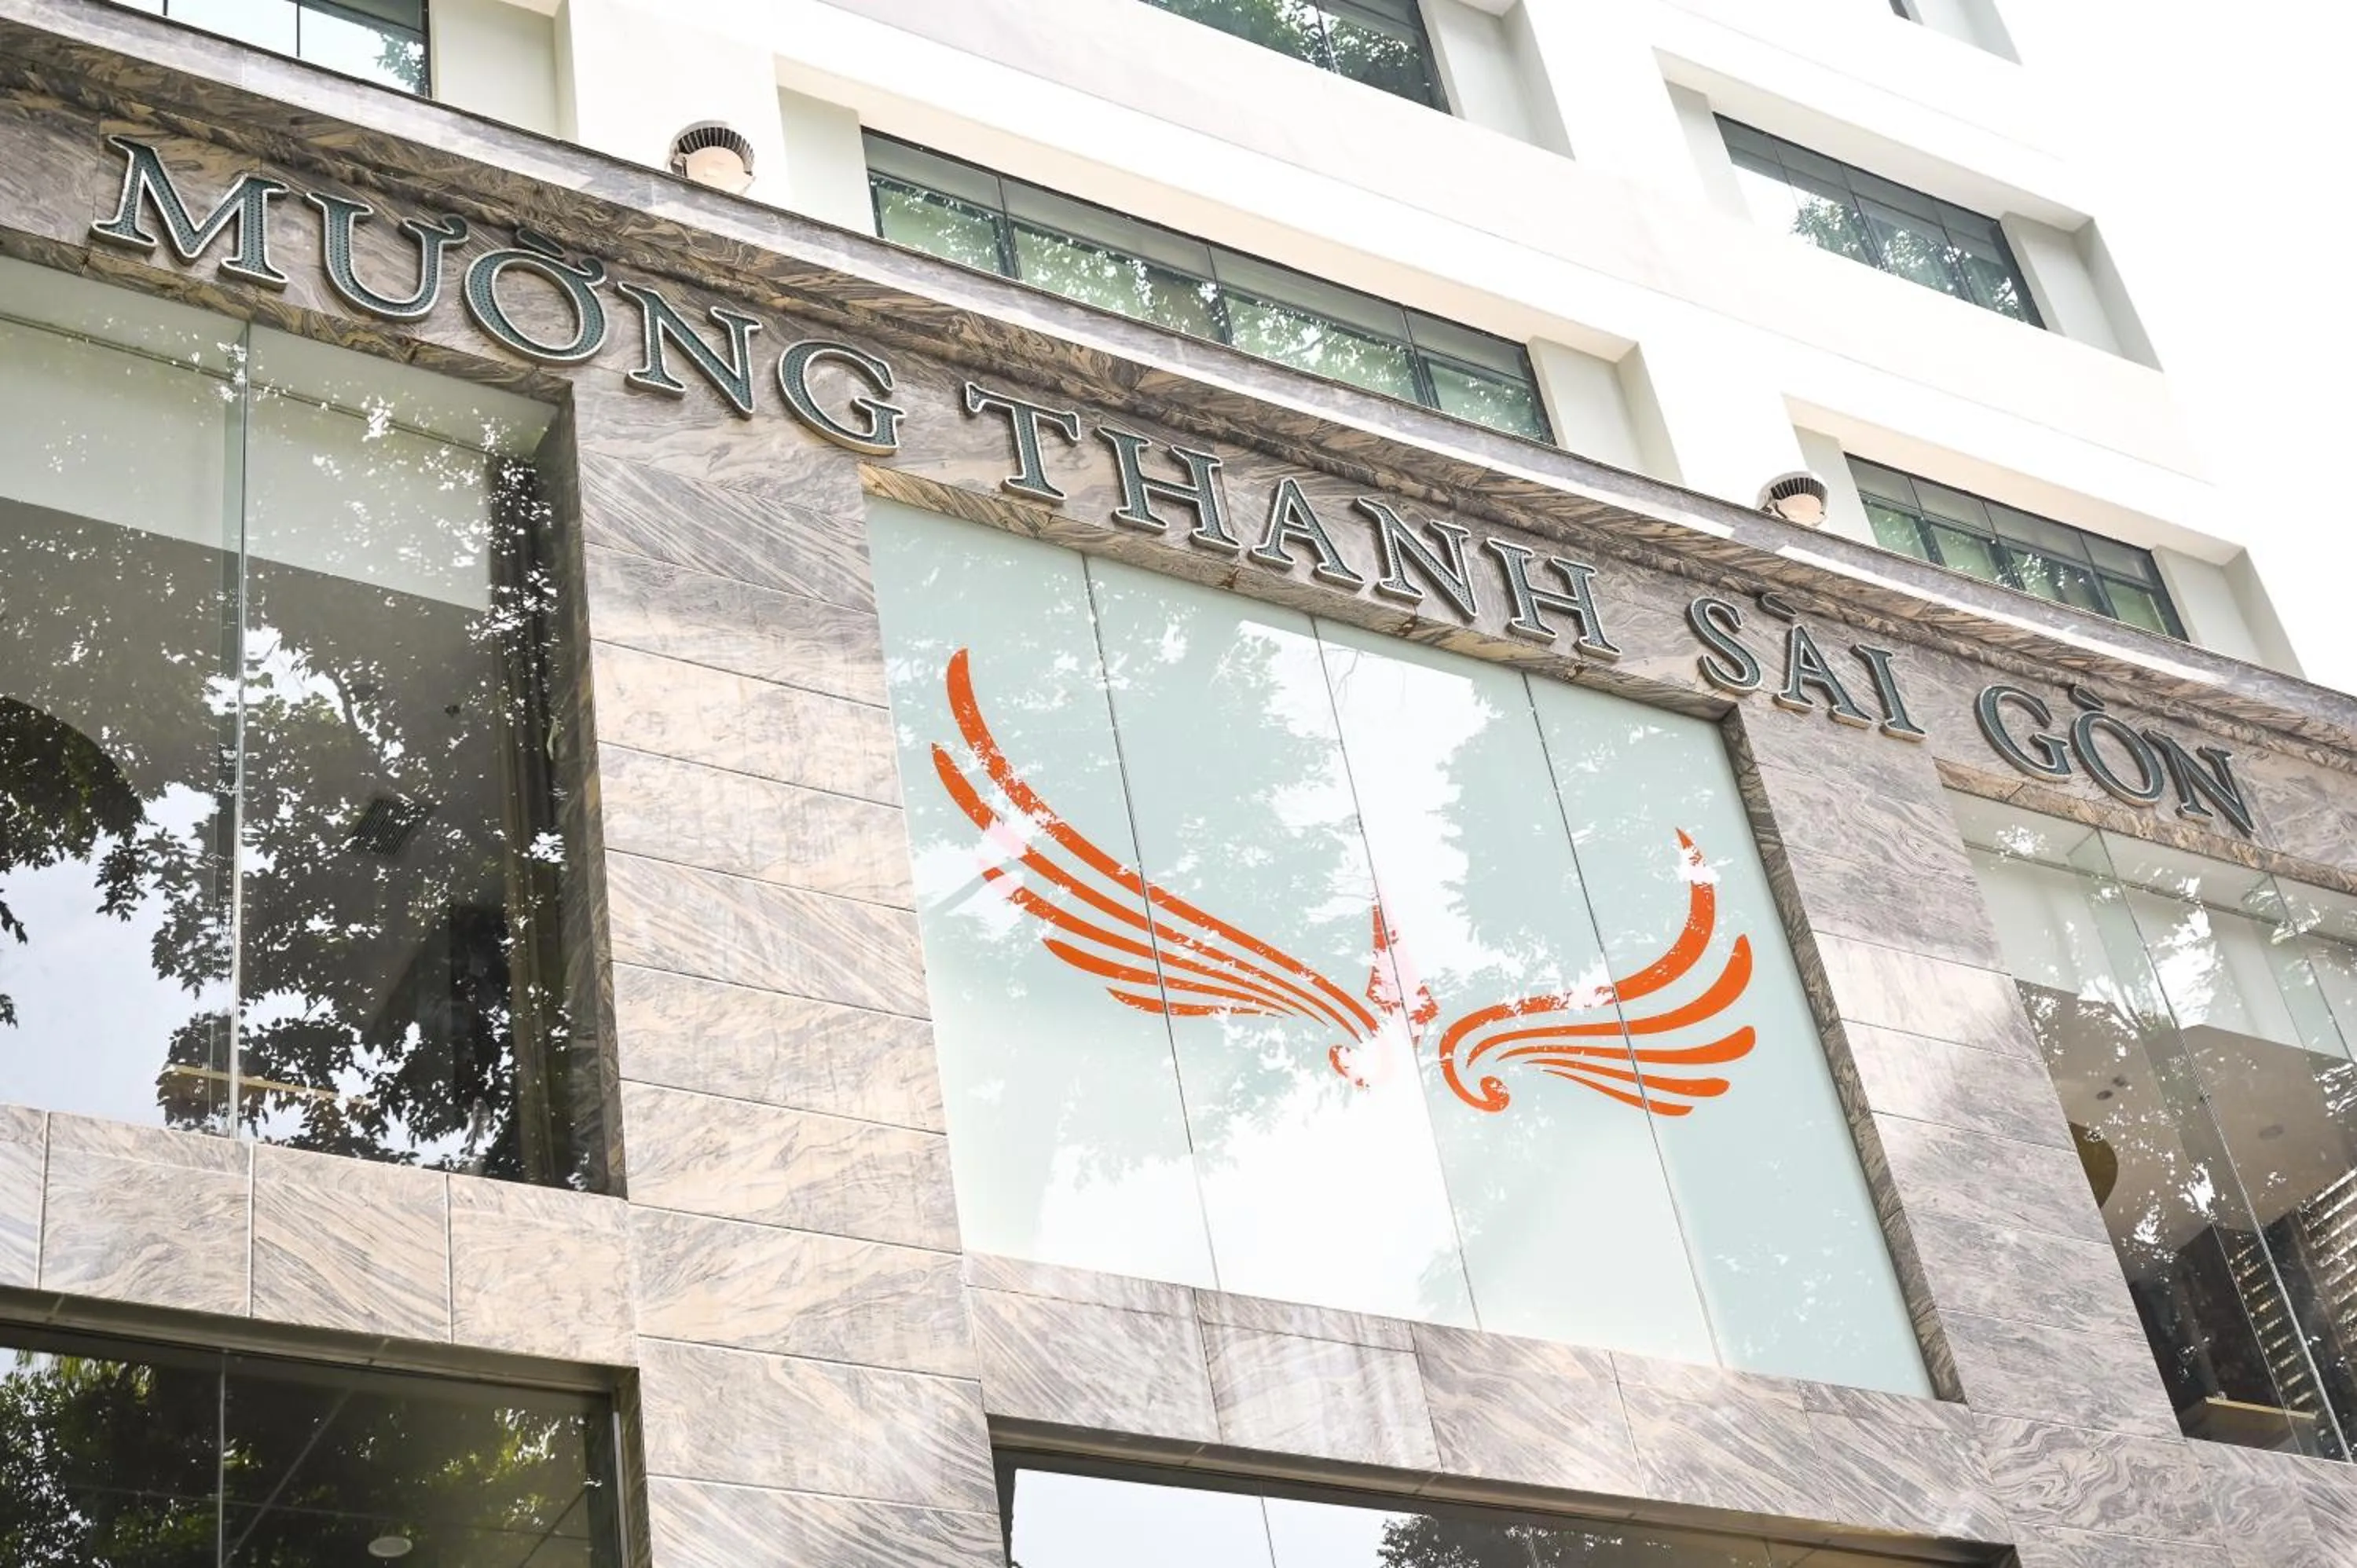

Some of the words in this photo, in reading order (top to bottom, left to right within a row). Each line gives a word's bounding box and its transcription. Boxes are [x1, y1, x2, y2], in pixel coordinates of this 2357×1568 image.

[89, 134, 907, 456] MƯỜNG
[964, 381, 1622, 661] THANH
[1686, 592, 1927, 742] SÀI
[1974, 683, 2260, 838] GÒN
